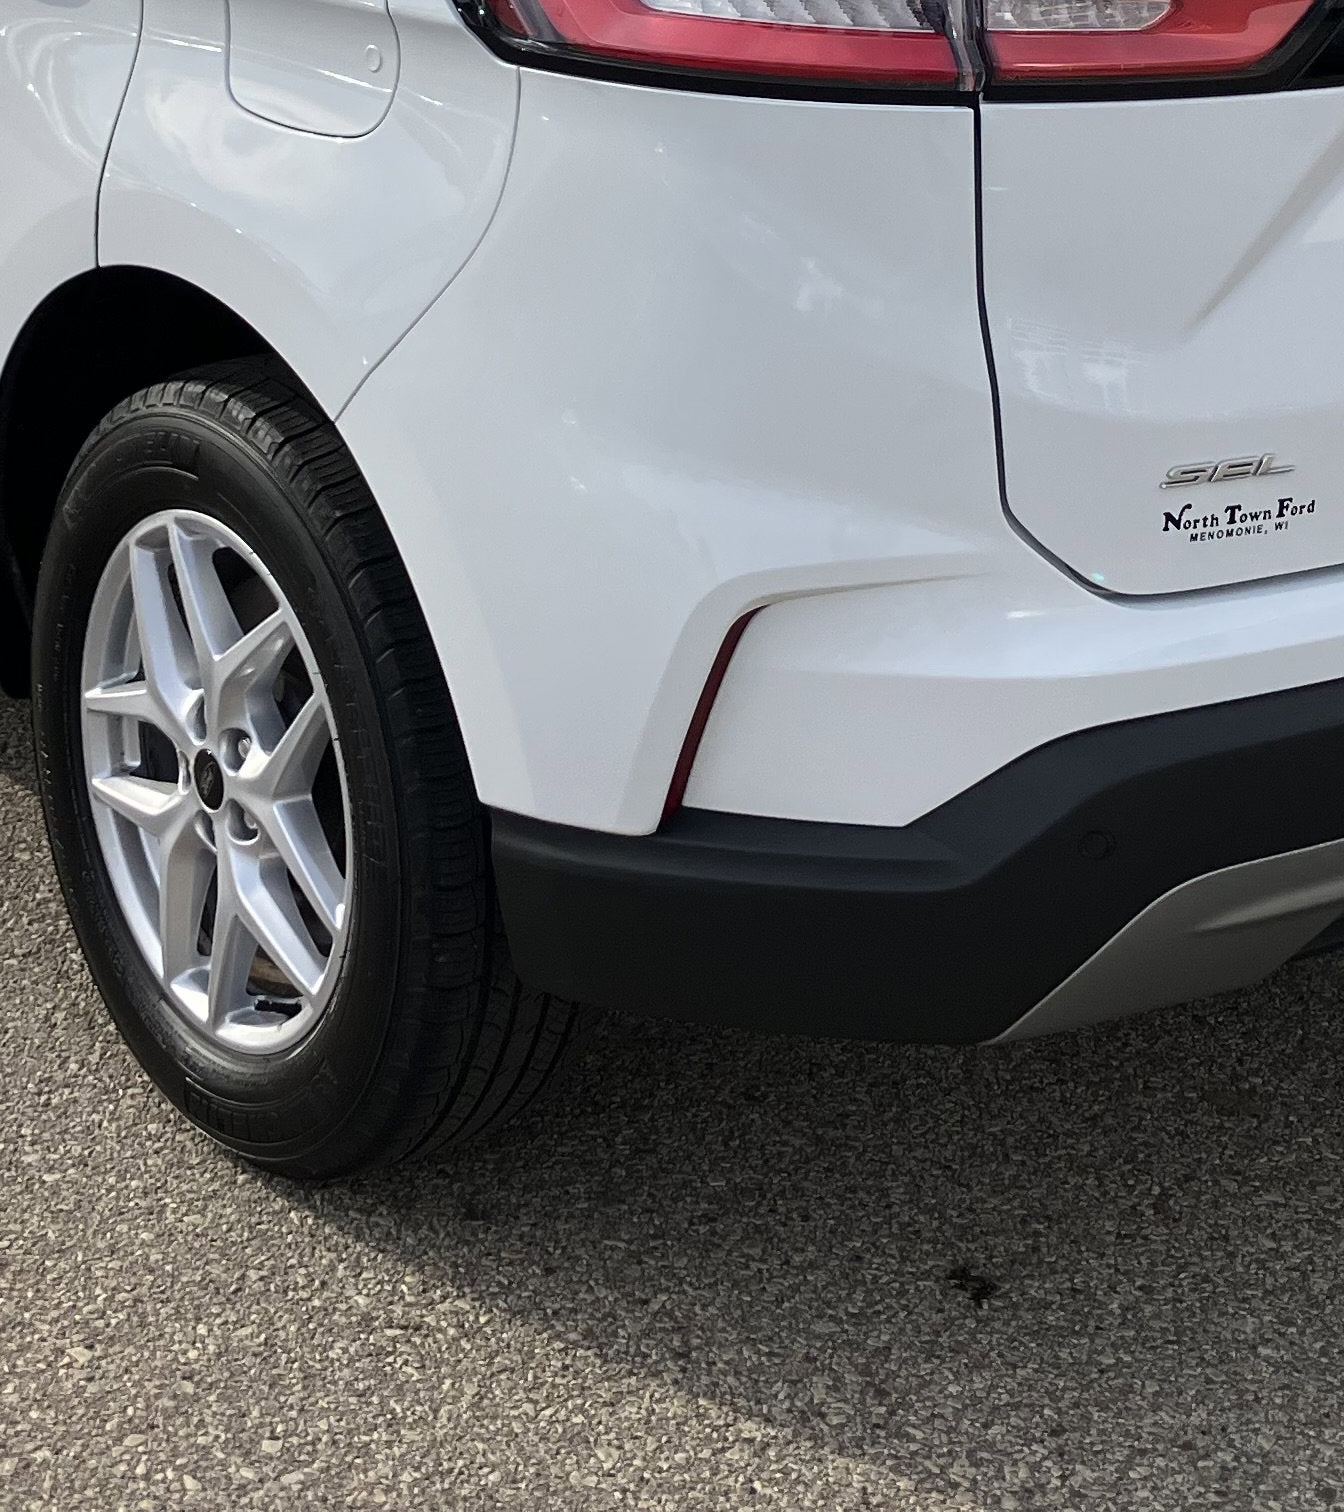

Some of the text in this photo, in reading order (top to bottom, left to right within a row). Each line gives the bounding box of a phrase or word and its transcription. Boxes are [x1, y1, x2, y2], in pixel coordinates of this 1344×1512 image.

[1159, 453, 1296, 488] SEL
[1162, 497, 1316, 531] North Town Ford
[1189, 520, 1289, 543] MENOMONIE, WI
